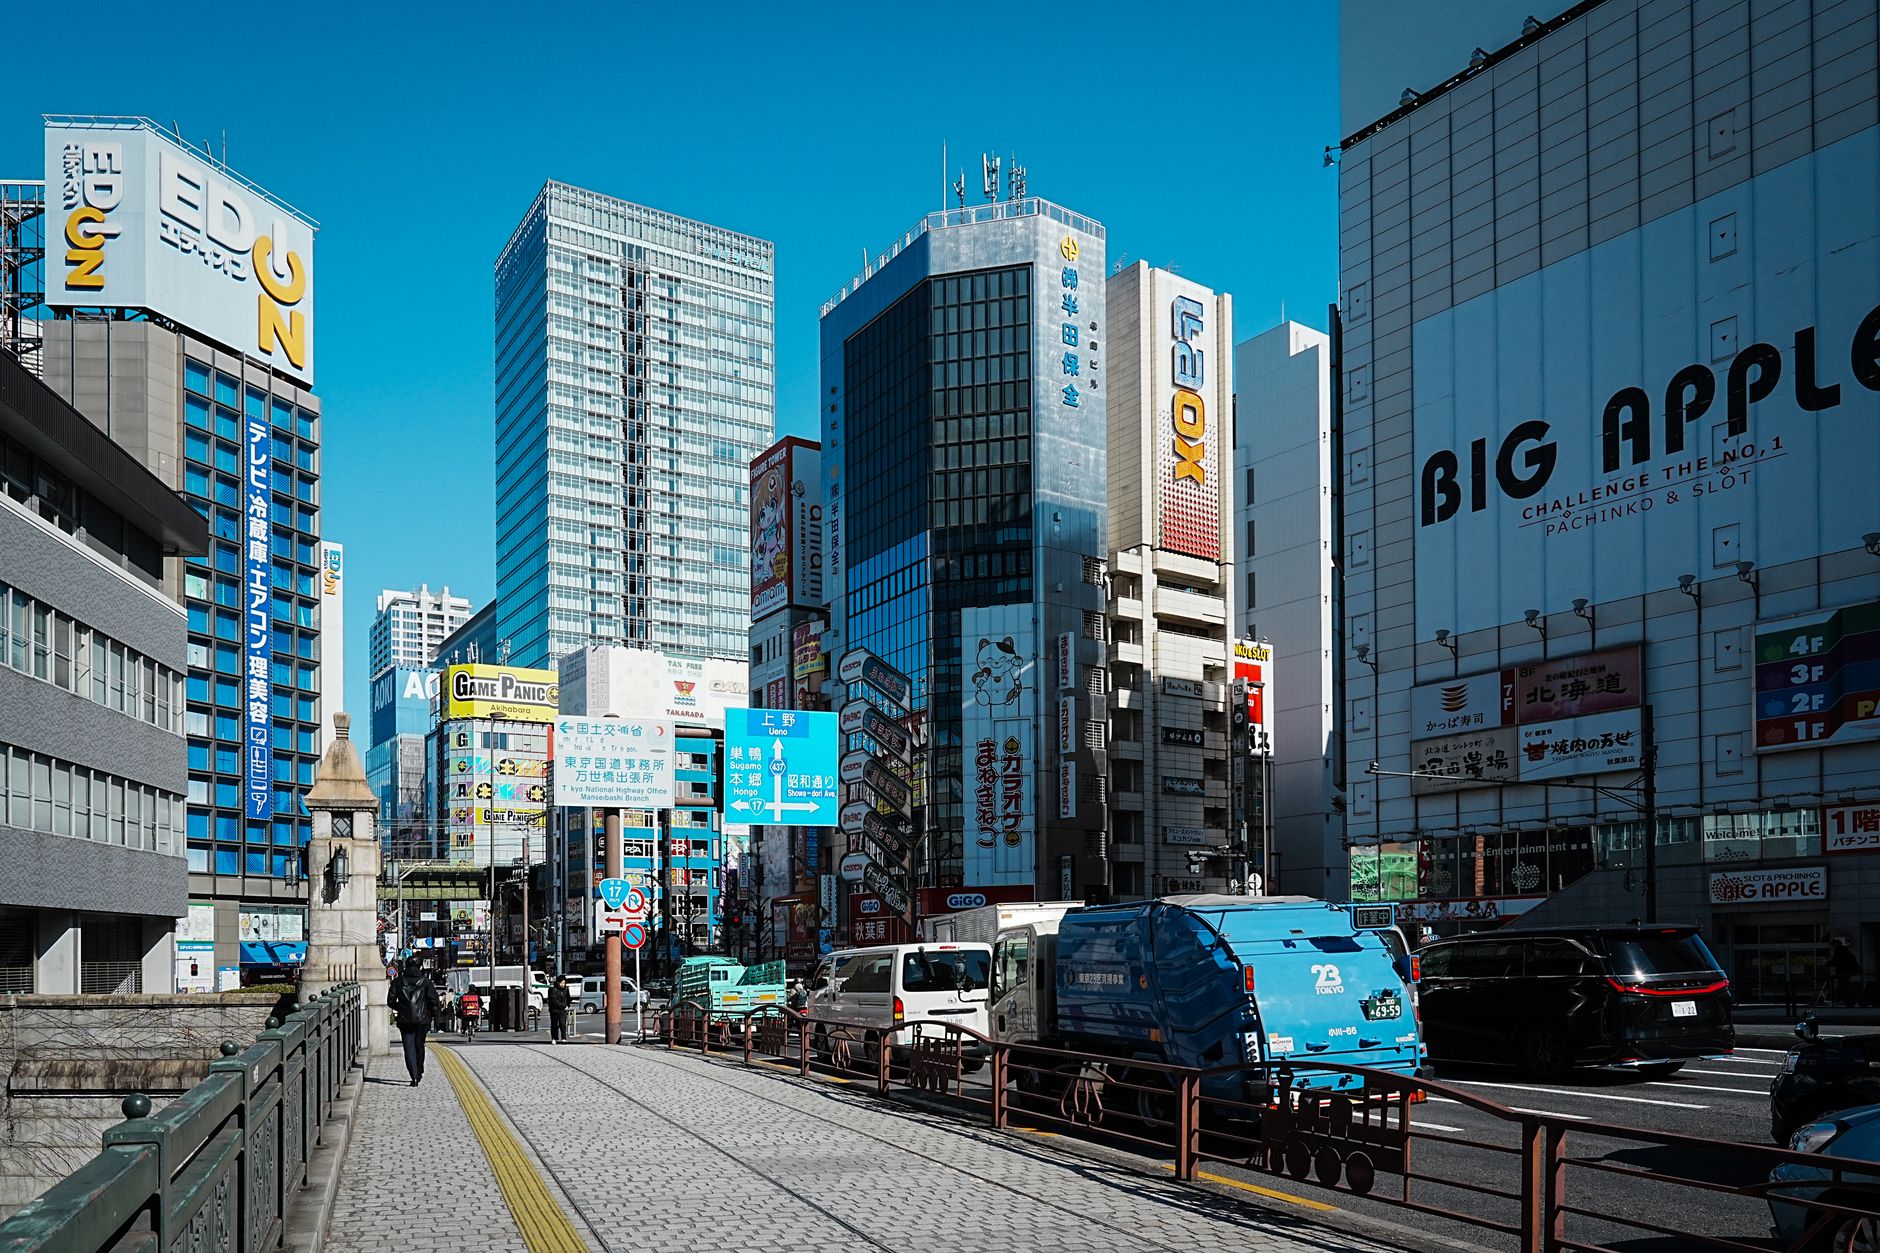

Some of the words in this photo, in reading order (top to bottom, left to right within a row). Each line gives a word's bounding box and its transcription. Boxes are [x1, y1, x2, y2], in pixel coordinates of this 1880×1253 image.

[1421, 420, 1557, 527] BIG
[1522, 474, 1650, 520] CHALLENGE
[1662, 456, 1709, 480] THE
[1545, 497, 1654, 537] PACHINKO
[1666, 490, 1680, 505] &
[1692, 470, 1752, 497] SLOT
[1790, 636, 1824, 655] 4F
[1520, 667, 1536, 678] 8F
[1790, 664, 1824, 684] 3F
[375, 674, 392, 712] AOKI
[457, 673, 498, 697] GAME
[502, 674, 545, 701] PANIC
[1526, 672, 1627, 705] 北海道
[490, 705, 531, 714] Akihabara
[1791, 693, 1824, 713] 2F
[665, 709, 704, 718] TAKARADA
[761, 712, 795, 727] 上野
[1426, 712, 1484, 732] かっぱ寿司
[769, 728, 788, 736] Ueno
[1794, 720, 1825, 741] 1F
[730, 746, 762, 761] 巣鴨
[565, 756, 664, 772] 東京国道事務所
[730, 762, 762, 771] Sugamo
[772, 763, 785, 771] 437
[576, 770, 654, 784] 万世橋出張所
[730, 772, 762, 787] 本郷
[788, 774, 835, 790] 昭和通り
[562, 785, 583, 795] Tkyo
[585, 786, 613, 794] National
[616, 786, 644, 796] Highway
[647, 787, 668, 796] Office
[581, 793, 623, 802] Manseibashi
[626, 794, 650, 803] Branch
[734, 787, 758, 797] Hongo
[788, 789, 822, 798] Showa-dori
[824, 790, 838, 798] Ave.
[976, 738, 998, 849] まねきねこ
[1003, 753, 1022, 830] カラオケ
[752, 801, 763, 811] 17
[1487, 842, 1566, 857] Entertainment
[609, 886, 622, 898] 17
[861, 901, 880, 911] GiGO
[949, 895, 985, 906] GiGO
[1359, 910, 1390, 926] 作業中
[855, 920, 887, 942] 秋葉原
[1311, 964, 1343, 987] 23
[1315, 985, 1344, 995] TOKYO
